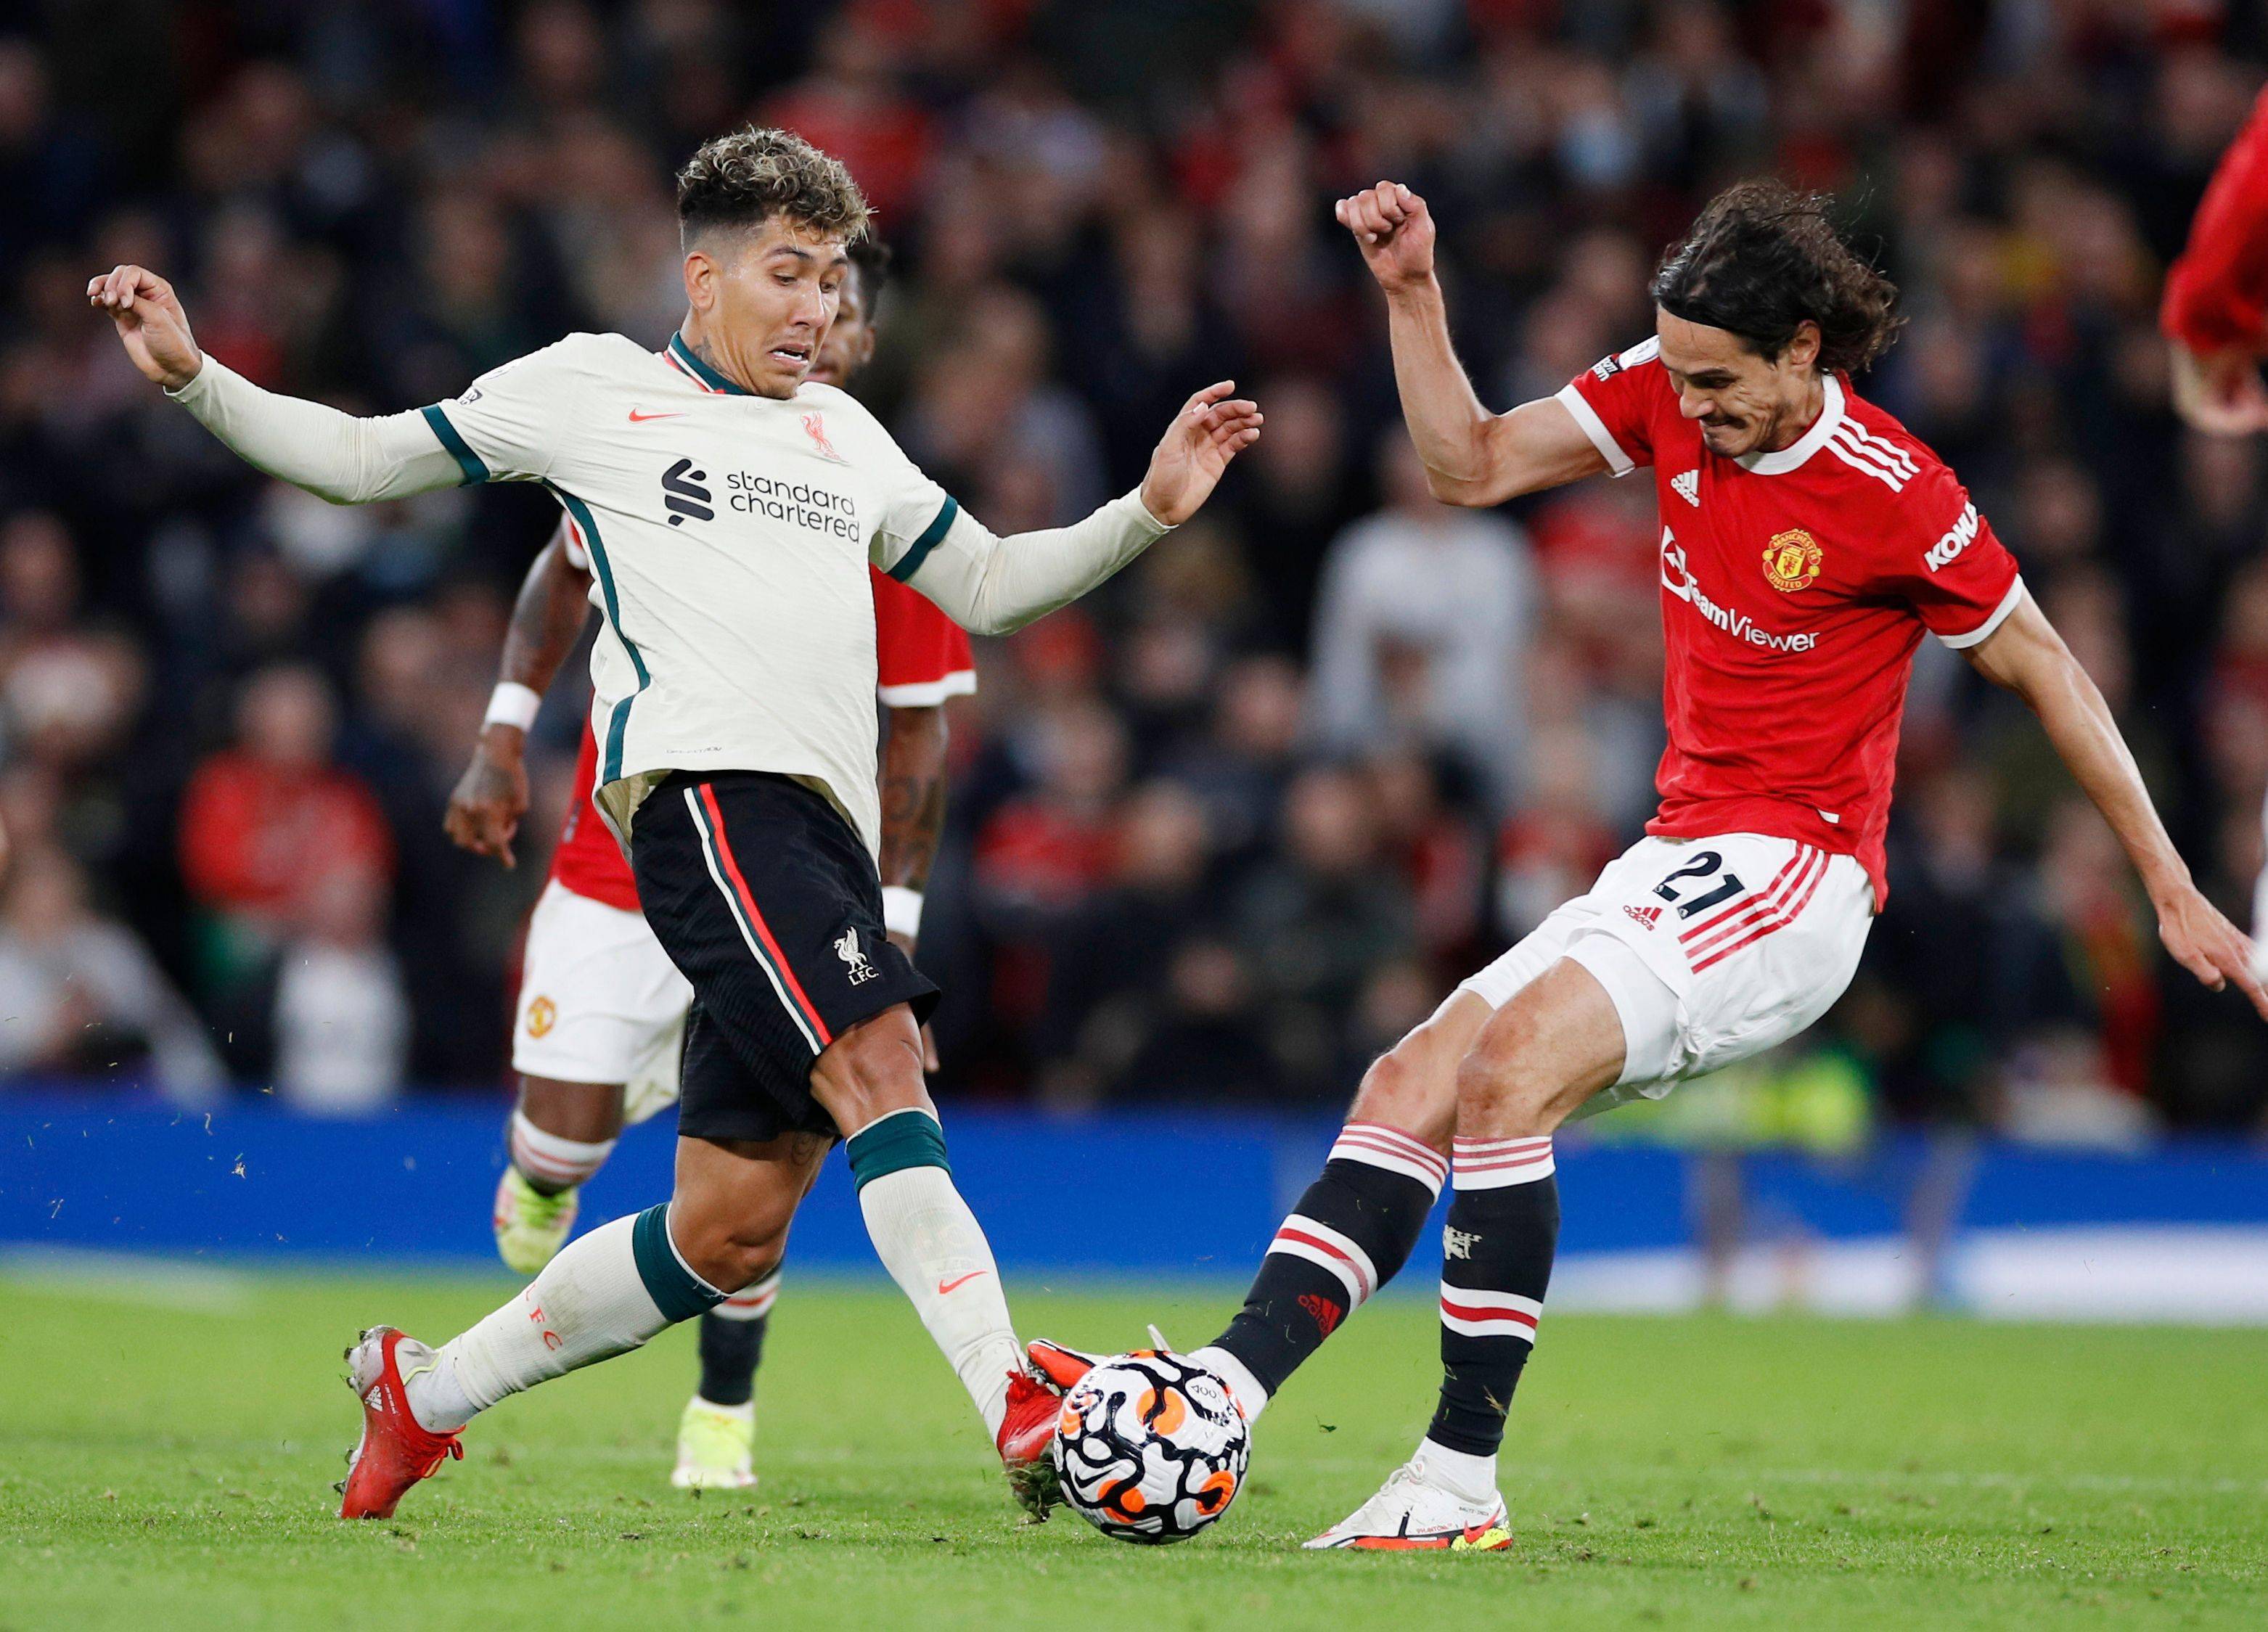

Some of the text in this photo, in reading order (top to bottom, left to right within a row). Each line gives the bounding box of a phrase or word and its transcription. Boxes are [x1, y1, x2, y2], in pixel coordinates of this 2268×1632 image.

[727, 471, 855, 517] standard
[1671, 477, 1700, 507] adidas
[730, 493, 860, 544] chartered
[1923, 500, 1978, 573] KOHL
[1772, 533, 1818, 561] MANCHESTER
[1769, 571, 1802, 589] UNITED
[1685, 571, 1820, 652] TeamViewer
[1652, 850, 1745, 920] 21
[1623, 905, 1655, 931] adidas
